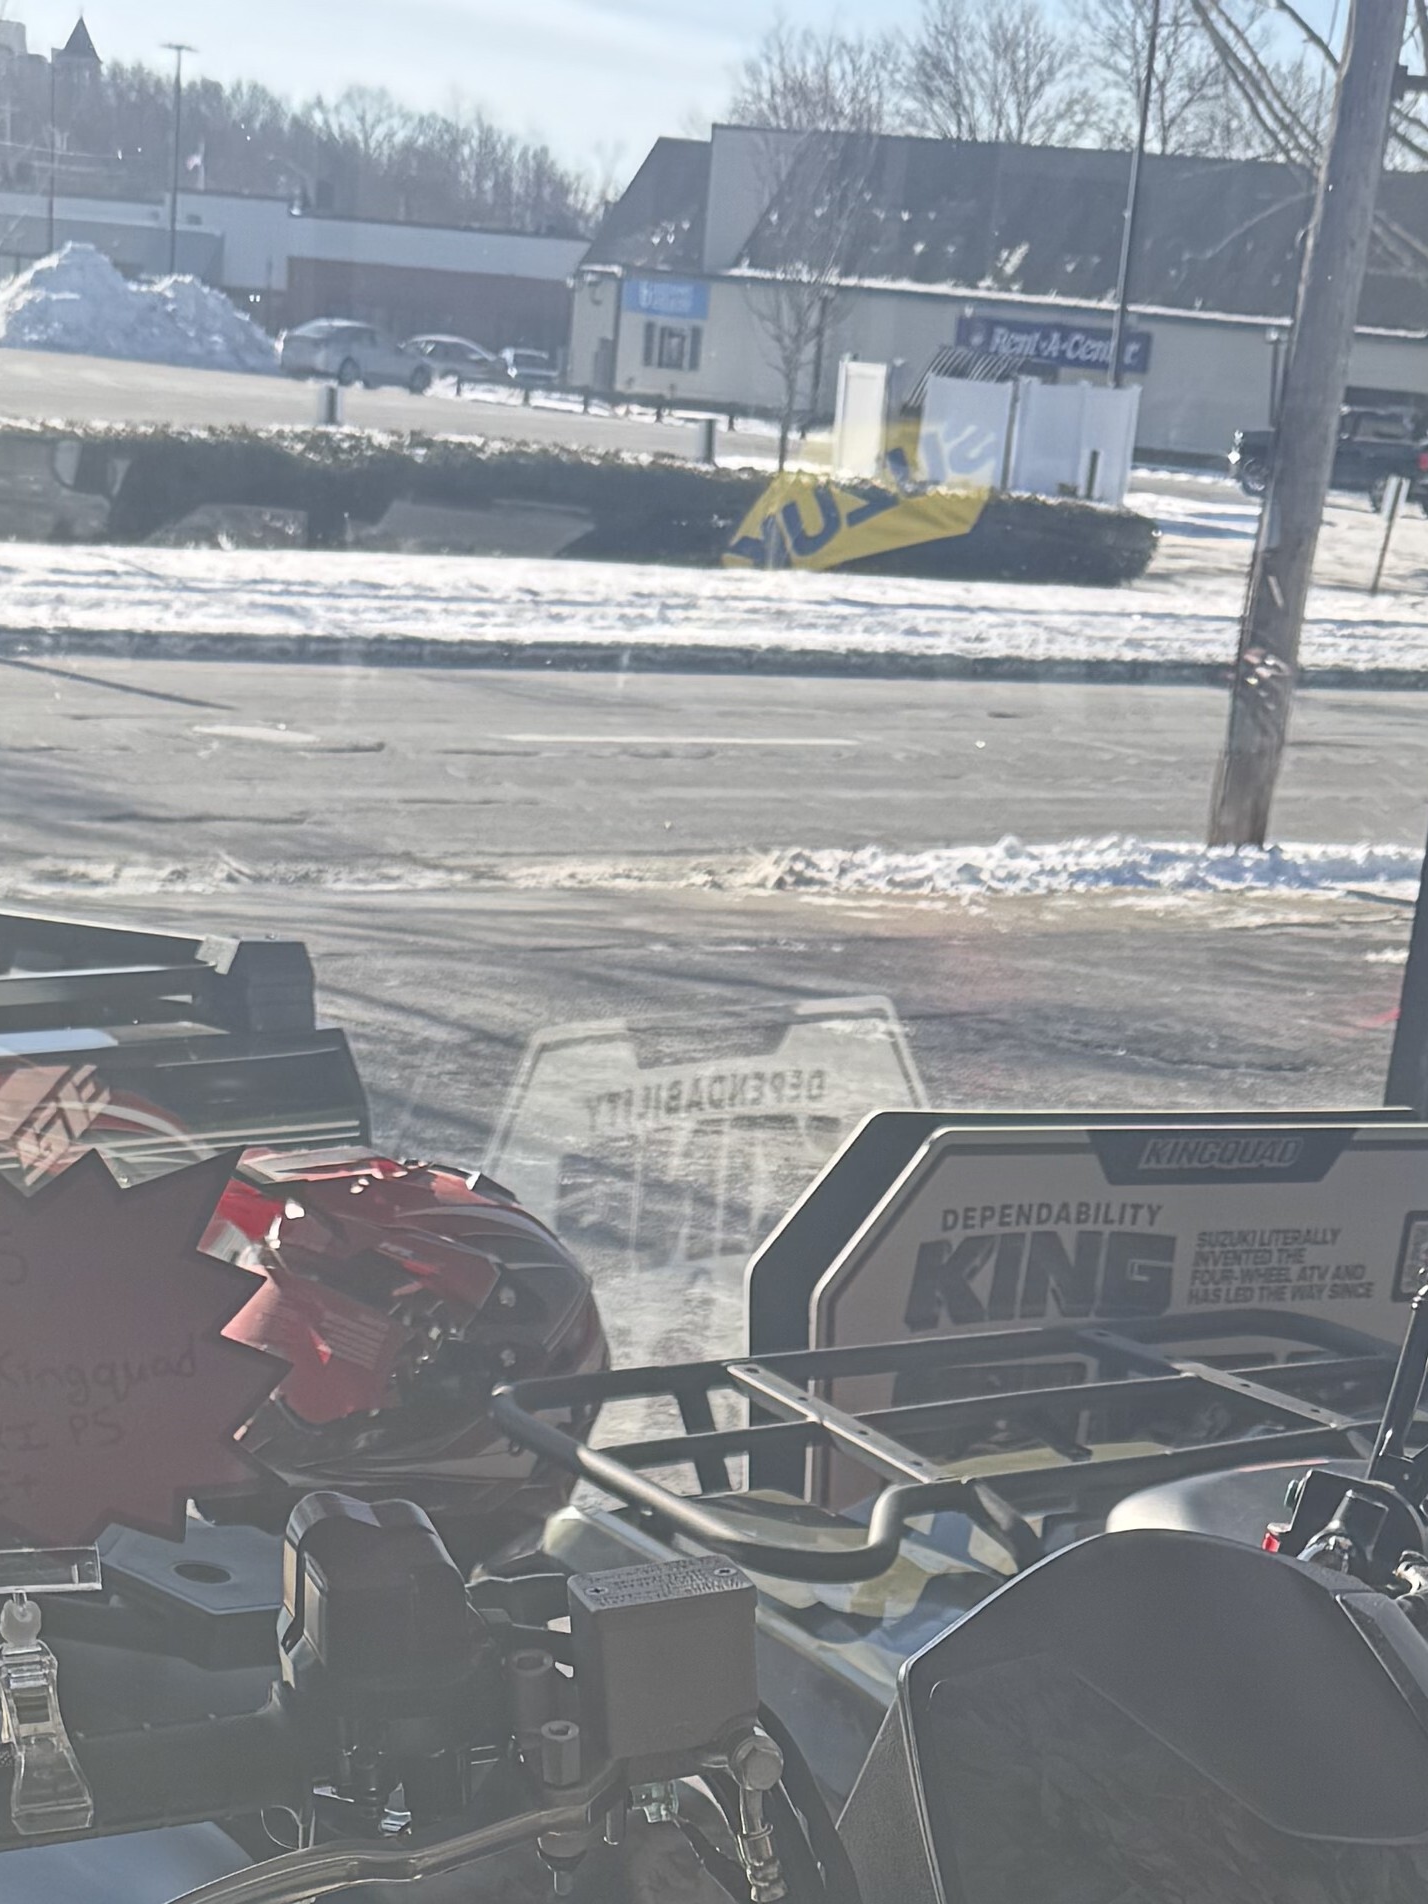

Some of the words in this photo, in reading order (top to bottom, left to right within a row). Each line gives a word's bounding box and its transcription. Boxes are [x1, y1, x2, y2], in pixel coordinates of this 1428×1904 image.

[1138, 1136, 1304, 1170] KINGQUAD
[941, 1201, 1163, 1232] DEPENDABILITY
[1196, 1230, 1256, 1248] SUZUKI
[1258, 1228, 1341, 1246] LITERALLY
[1193, 1249, 1272, 1267] INVENTED
[1276, 1248, 1306, 1264] THE
[903, 1230, 1177, 1334] KING
[1190, 1267, 1292, 1286] FOUR-WHEEL
[1297, 1265, 1330, 1281] ATV
[1331, 1264, 1366, 1281] AND
[1188, 1287, 1222, 1304] HAS
[1225, 1286, 1255, 1303] LED
[1258, 1285, 1287, 1301] THE
[1291, 1284, 1327, 1300] WAY
[1328, 1282, 1374, 1299] SINCE
